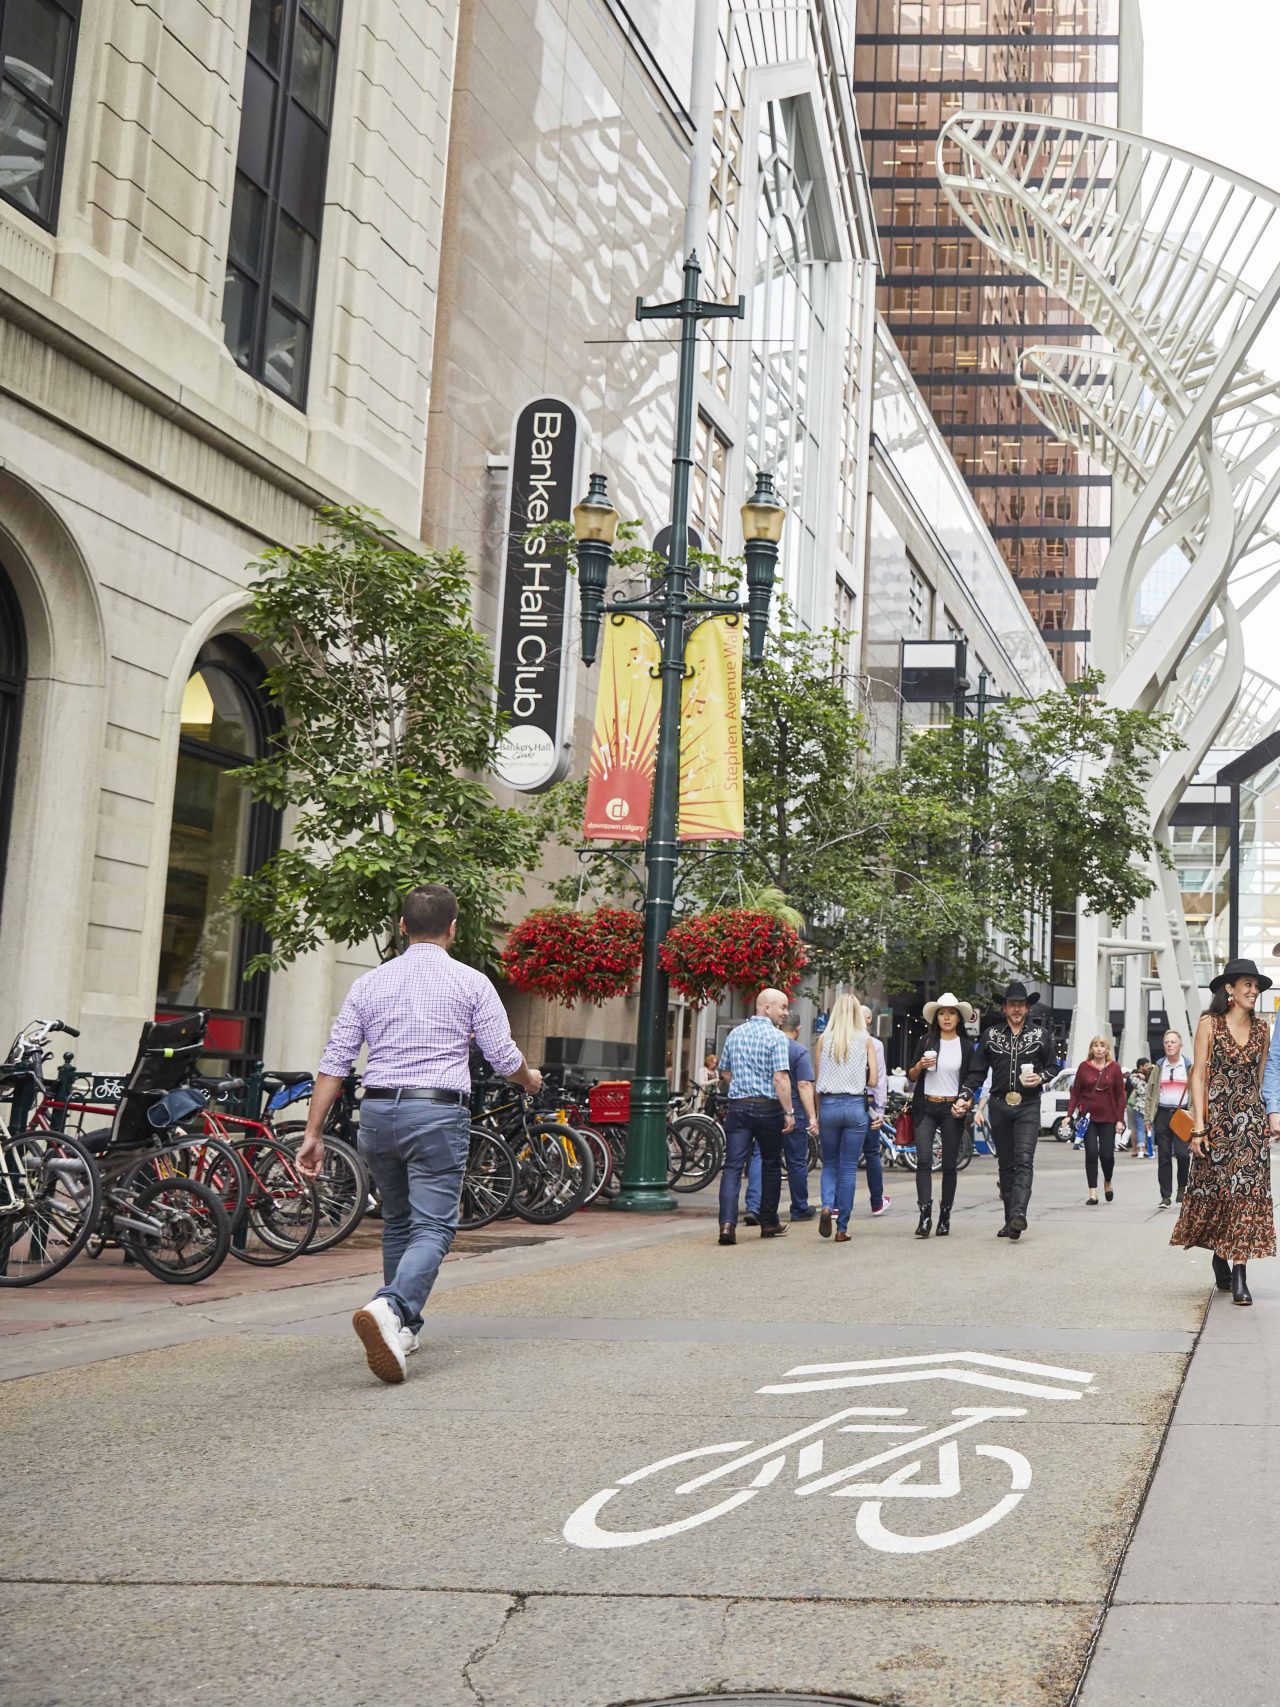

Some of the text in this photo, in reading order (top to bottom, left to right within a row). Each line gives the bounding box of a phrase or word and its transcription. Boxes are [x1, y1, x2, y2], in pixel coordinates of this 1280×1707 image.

[520, 563, 552, 627] Hall
[513, 635, 547, 718] Club
[724, 662, 738, 720] Avenue
[723, 725, 741, 791] Stephen
[587, 821, 645, 833] downtown calgary
